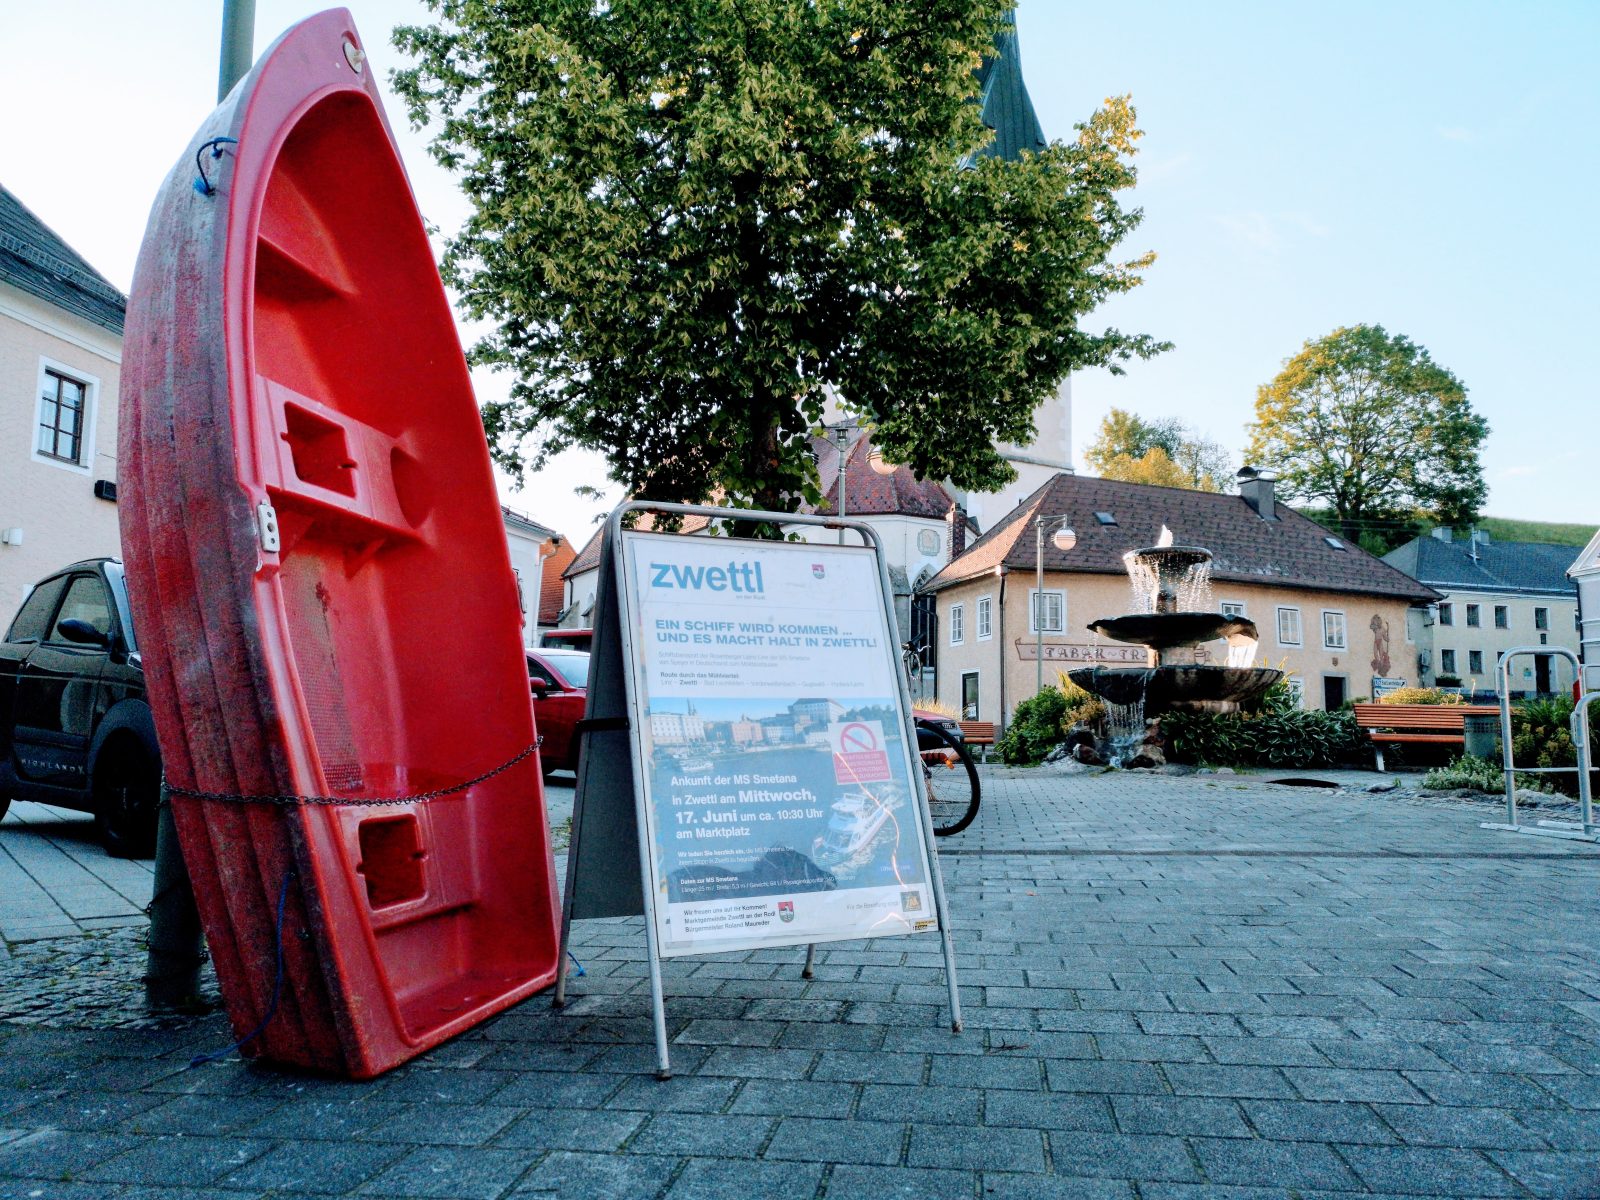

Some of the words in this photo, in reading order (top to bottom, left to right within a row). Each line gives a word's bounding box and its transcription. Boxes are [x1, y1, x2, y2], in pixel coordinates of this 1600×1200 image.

[650, 560, 764, 593] zwettl
[655, 619, 680, 630] EIN
[684, 620, 735, 631] SCHIFF
[739, 622, 774, 633] WIRD
[780, 624, 838, 635] KOMMEN
[656, 632, 689, 643] UND
[694, 634, 712, 644] ES
[716, 634, 765, 646] MACHT
[769, 636, 801, 647] HALT
[806, 637, 818, 647] IN
[822, 638, 877, 648] ZWETTL!
[1045, 647, 1107, 660] TABAK
[671, 775, 711, 786] Ankunft
[714, 775, 730, 785] der
[733, 774, 750, 785] MS
[753, 773, 797, 784] Smetana
[672, 795, 682, 805] in
[684, 794, 718, 805] Zwettl
[719, 795, 736, 804] am
[738, 788, 816, 803] Mittwoch,
[675, 811, 697, 824] 17.
[702, 809, 737, 823] Juni
[741, 813, 756, 822] um
[759, 812, 774, 821] ca.
[777, 810, 803, 820] 10:30
[806, 809, 824, 819] Uhr
[676, 830, 692, 839] am
[696, 828, 750, 839] Marktplatz
